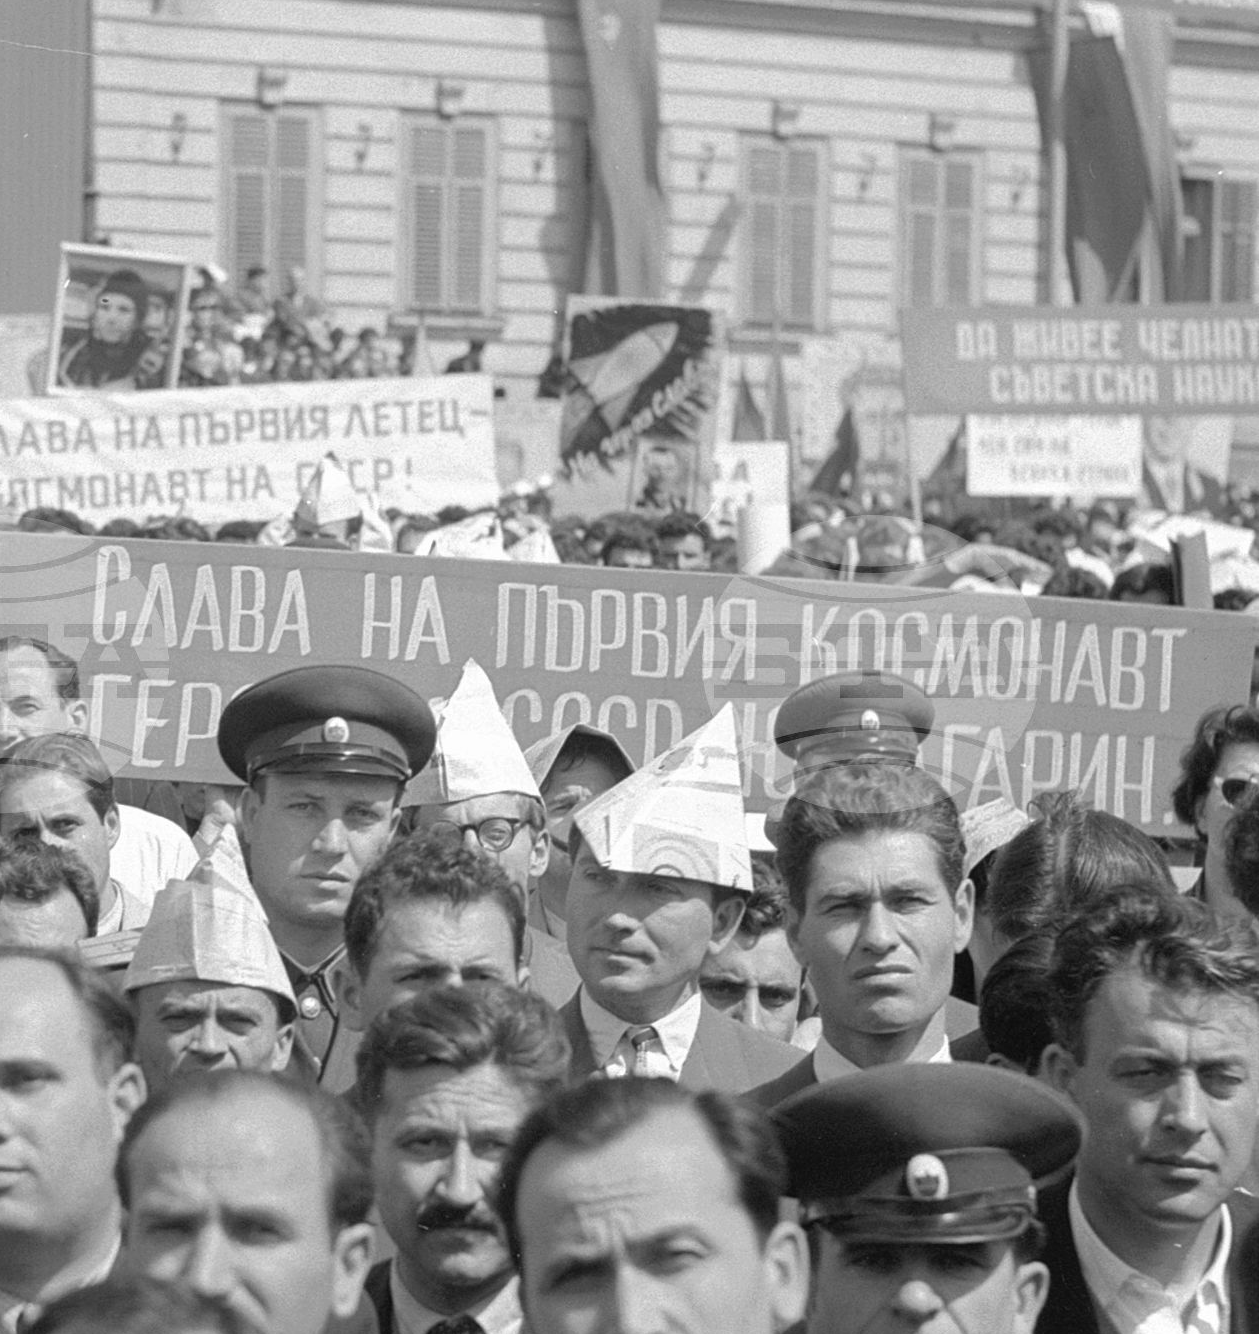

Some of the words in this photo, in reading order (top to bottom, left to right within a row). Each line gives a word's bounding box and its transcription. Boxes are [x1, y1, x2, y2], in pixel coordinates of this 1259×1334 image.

[955, 319, 998, 361] ДА
[1012, 318, 1123, 361] ЖИВЕЕ
[989, 364, 1160, 405] СЪВЕТСКА
[1173, 364, 1259, 405] НАУК
[114, 415, 164, 451] НА
[179, 403, 331, 446] ПЪРВИЯ
[225, 464, 275, 502] НА
[92, 544, 312, 655] СЛАВА
[362, 572, 451, 665] НА
[495, 581, 757, 682] ПЪРВИЯ
[799, 603, 1188, 714] КОСМОНАВТ
[90, 673, 252, 768] ГЕР
[916, 723, 1174, 826] ГАРИН.
